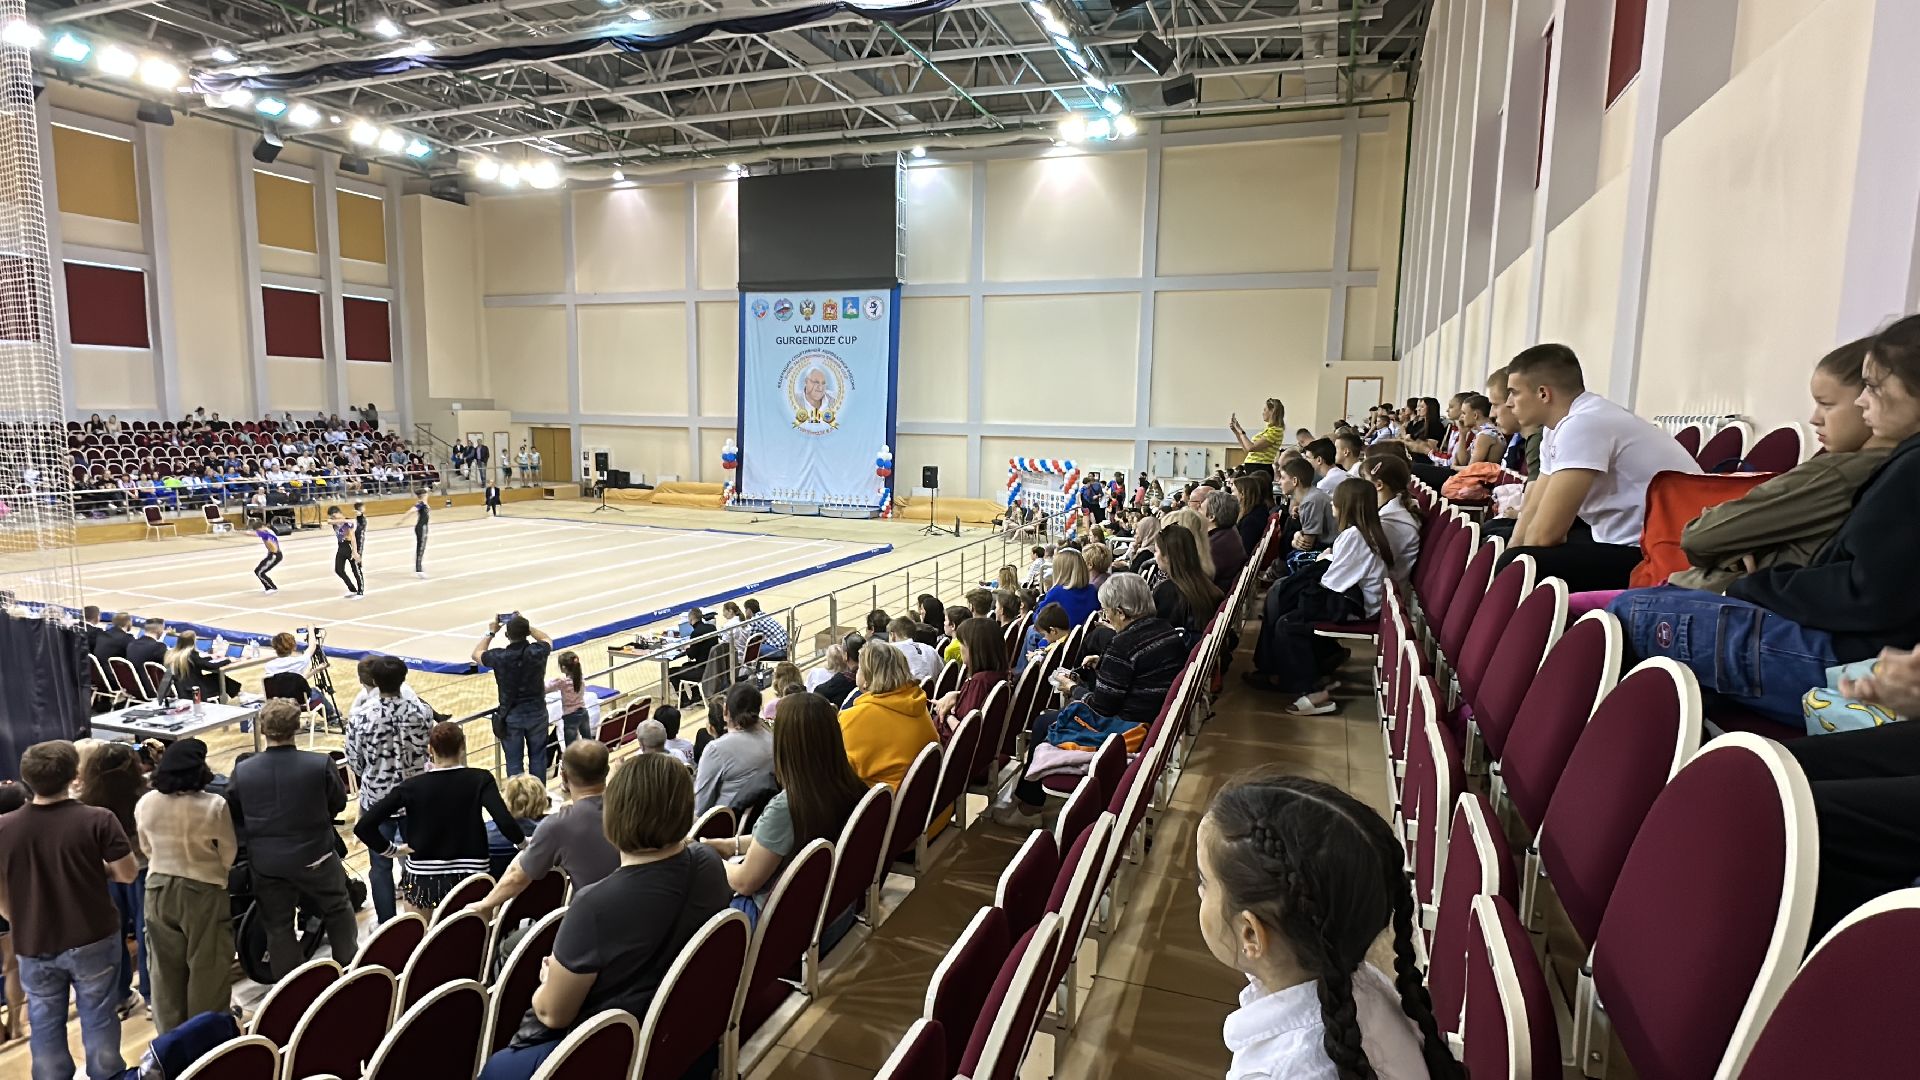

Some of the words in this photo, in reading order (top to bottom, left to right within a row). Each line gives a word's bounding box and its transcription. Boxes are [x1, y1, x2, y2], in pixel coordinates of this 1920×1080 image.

[794, 325, 838, 333] VLADIMIR
[775, 336, 836, 345] GURGENIDZE
[838, 336, 858, 345] CUP
